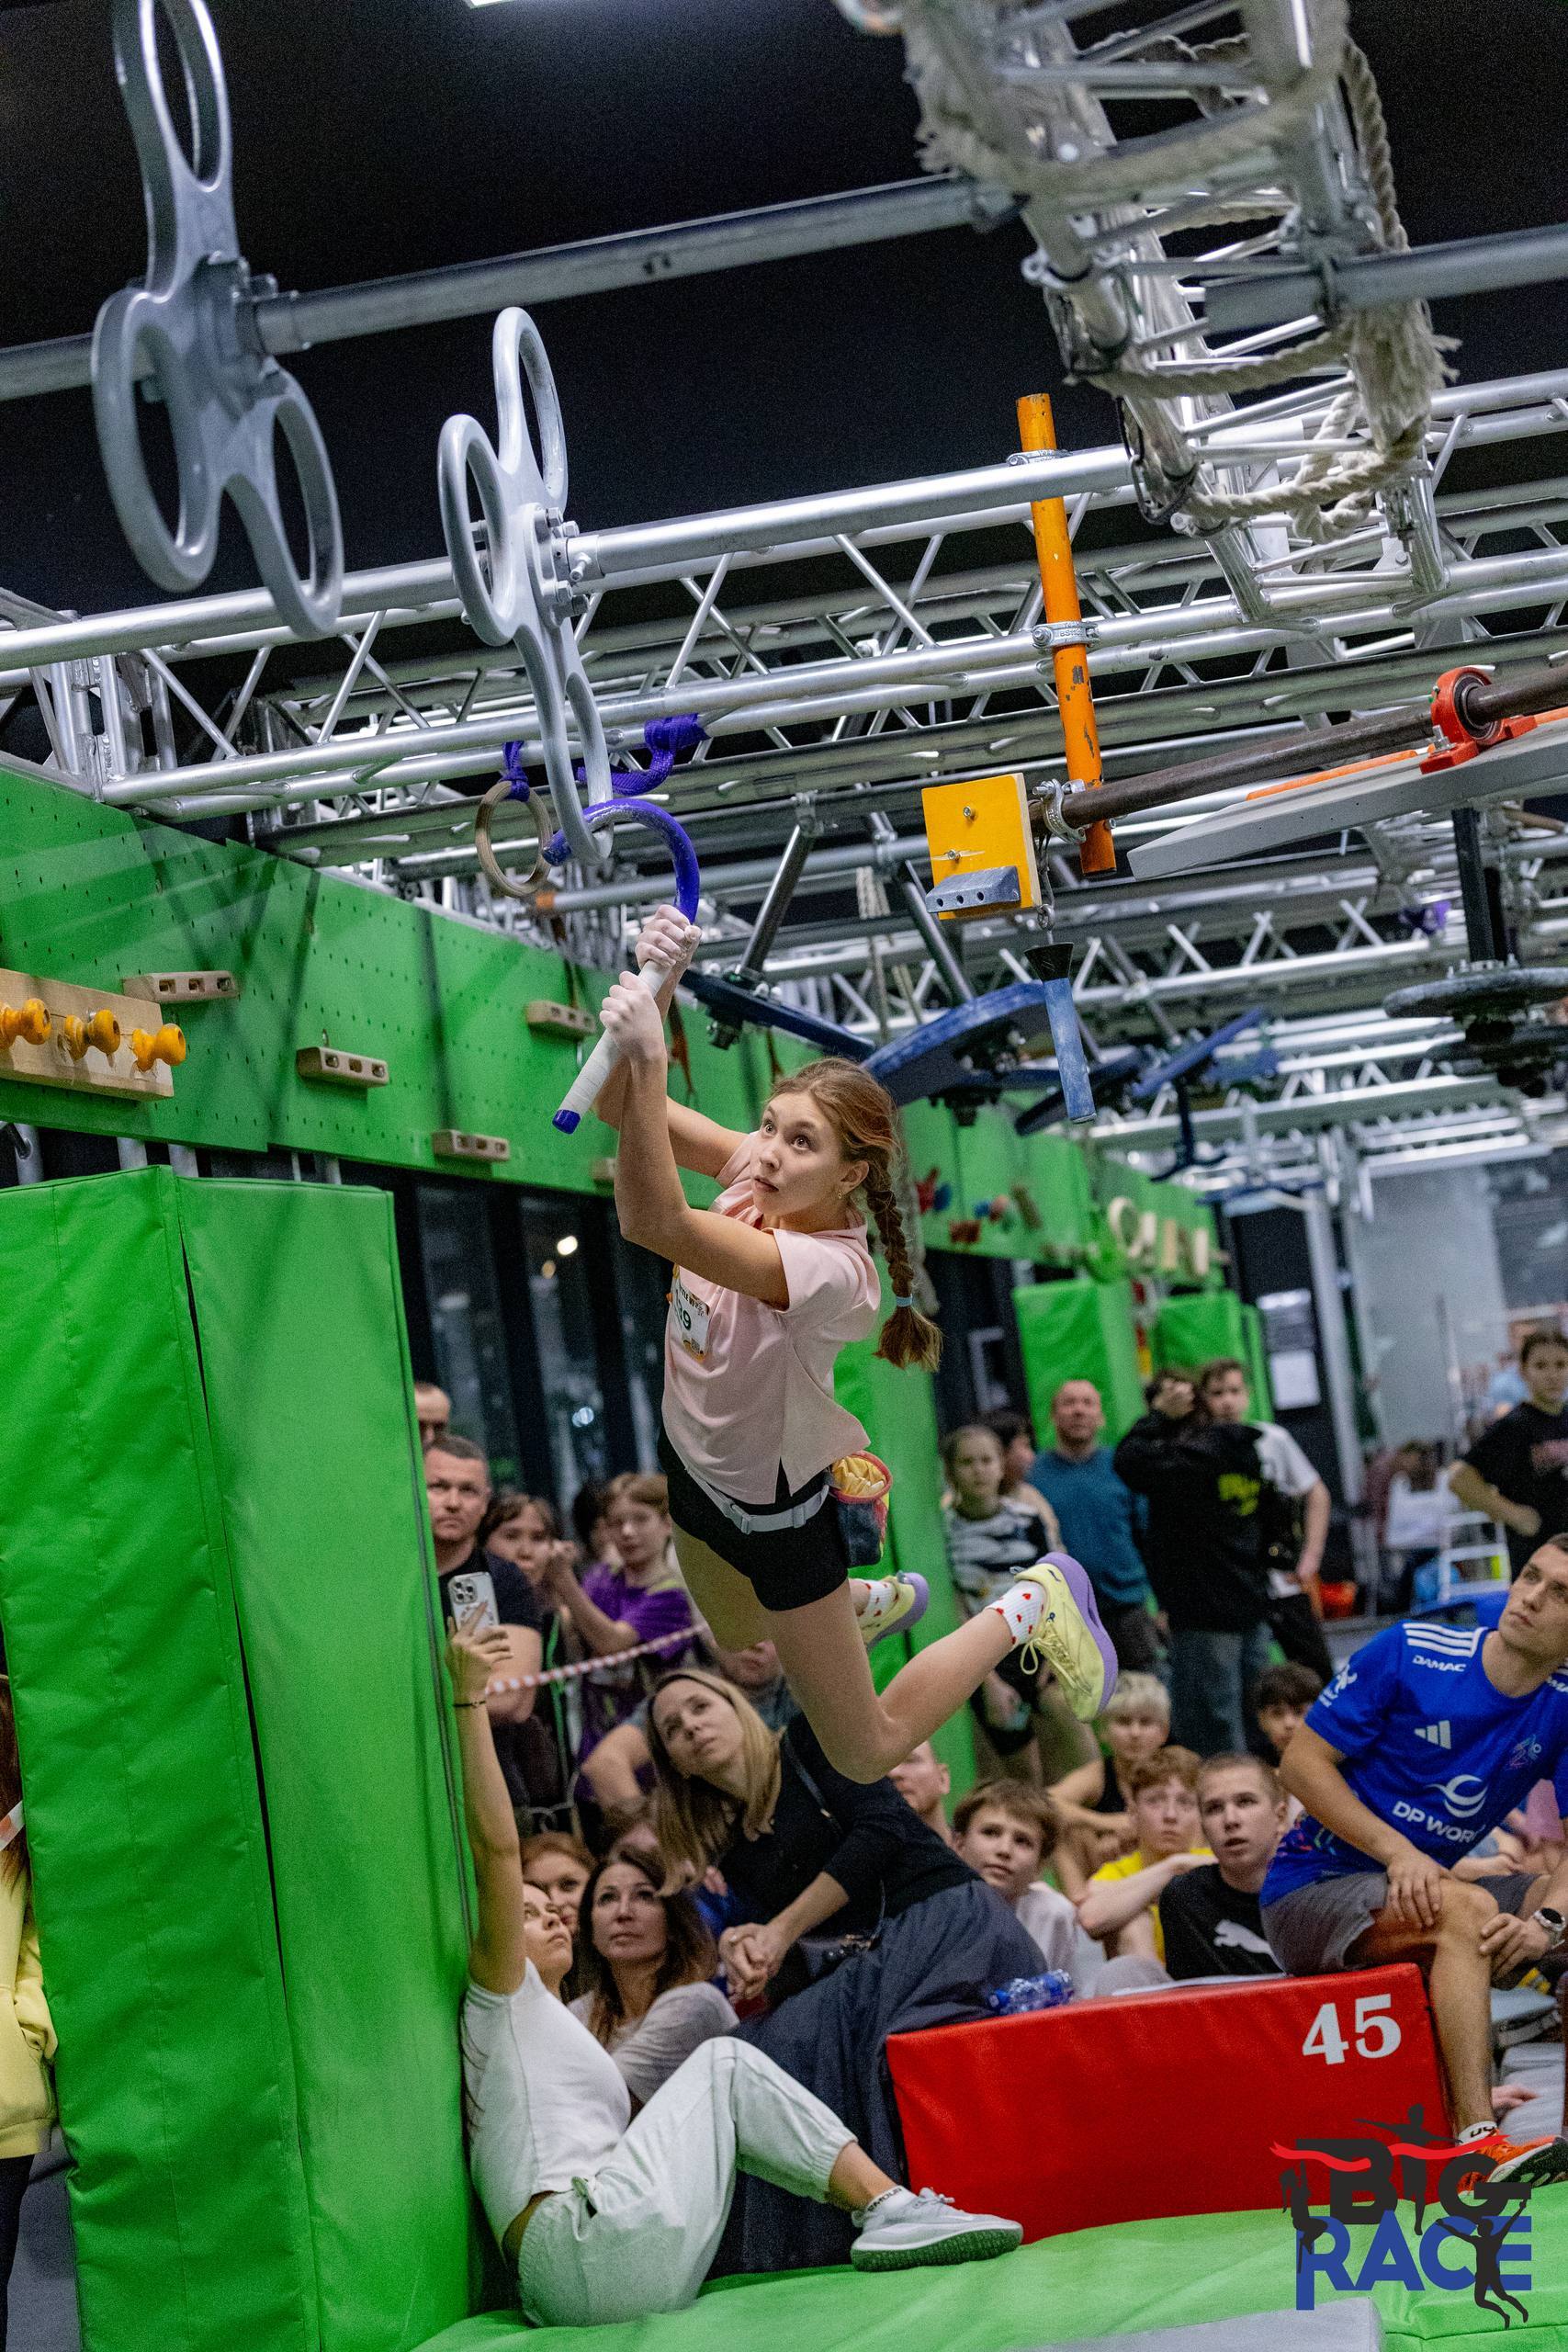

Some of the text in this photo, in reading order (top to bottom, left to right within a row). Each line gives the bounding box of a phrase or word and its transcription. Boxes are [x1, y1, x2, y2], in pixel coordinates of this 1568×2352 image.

[1412, 1655, 1467, 1672] DAMAC
[1393, 1801, 1485, 1843] DP WOR
[1302, 1993, 1402, 2065] 45
